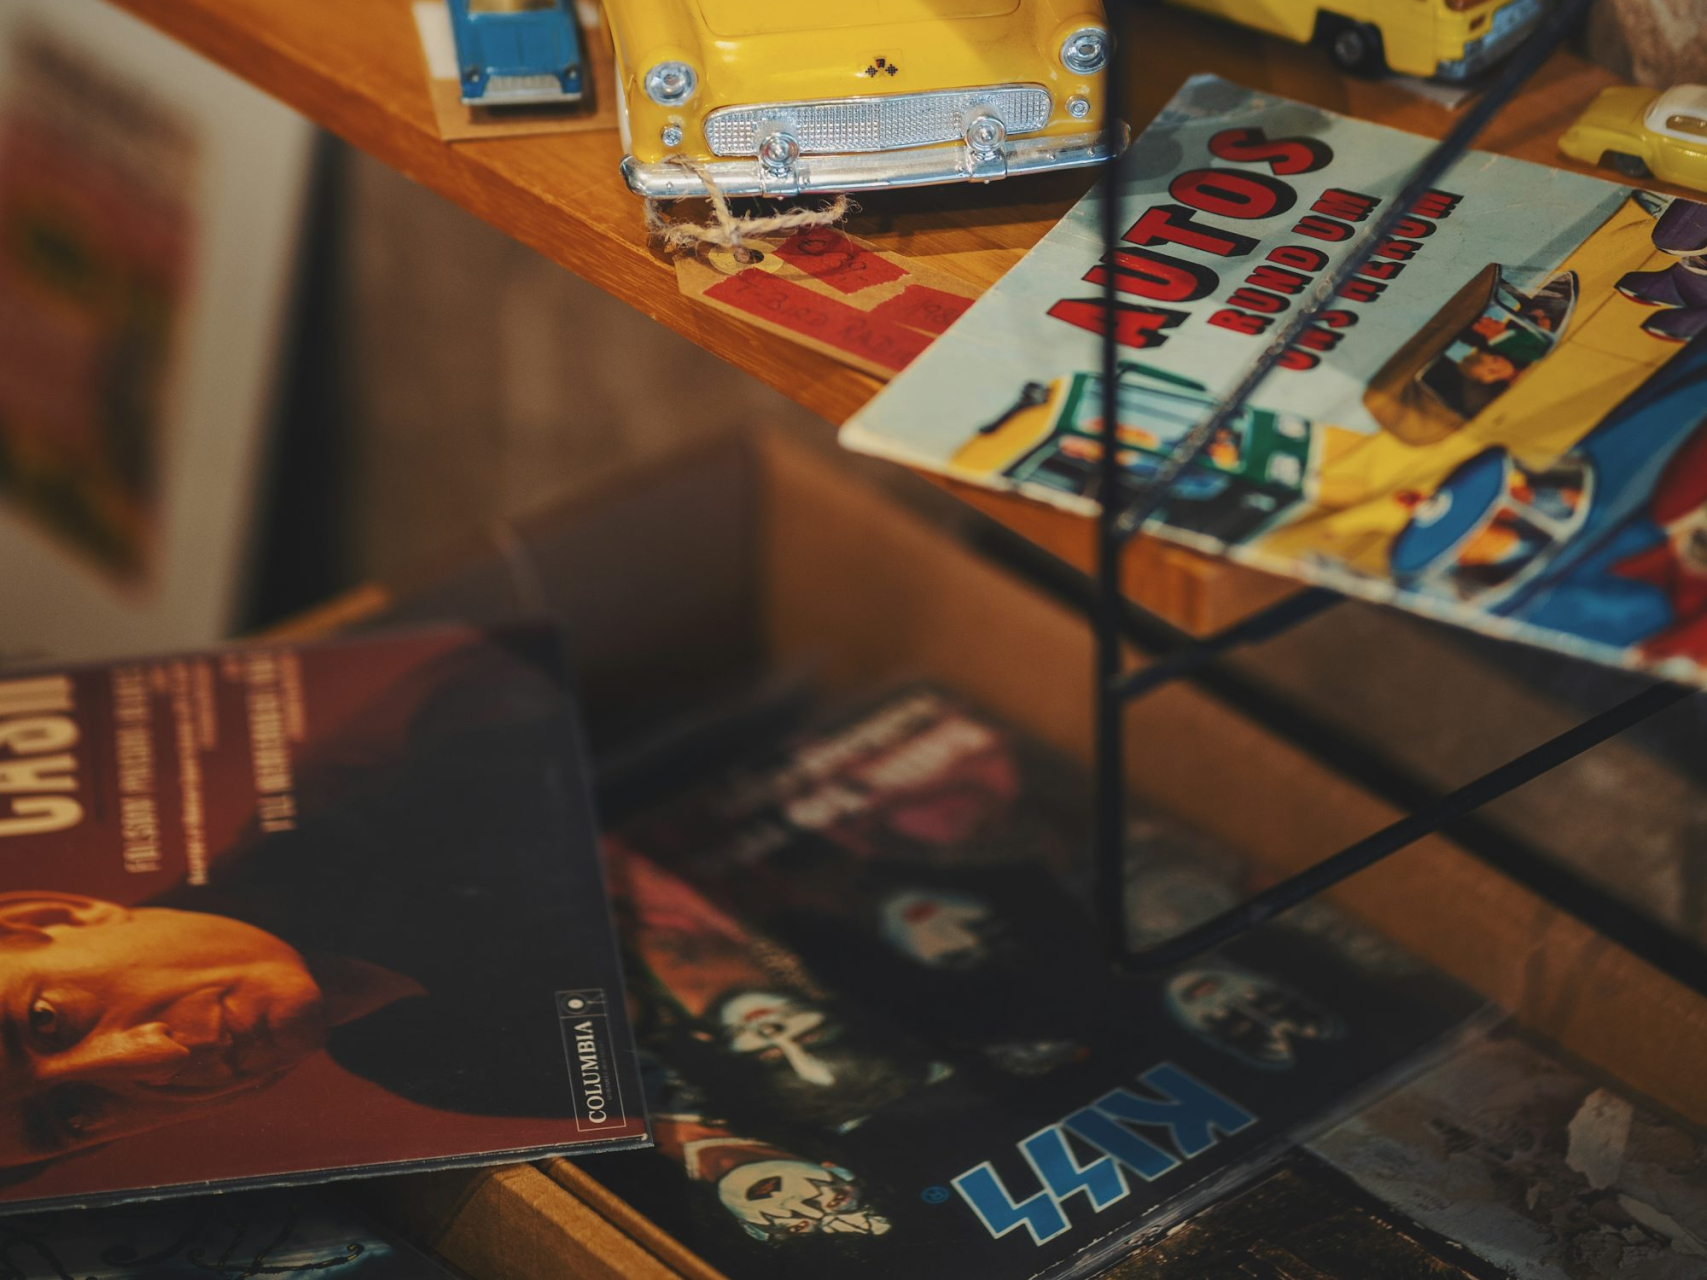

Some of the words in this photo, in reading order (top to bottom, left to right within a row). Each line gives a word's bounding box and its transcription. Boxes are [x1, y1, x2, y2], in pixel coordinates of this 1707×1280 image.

[1047, 127, 1334, 349] AUTOS
[1207, 245, 1330, 336] RUND
[1291, 187, 1383, 243] UM
[574, 1020, 607, 1125] COLUMBIA
[950, 1060, 1258, 1247] KISS
